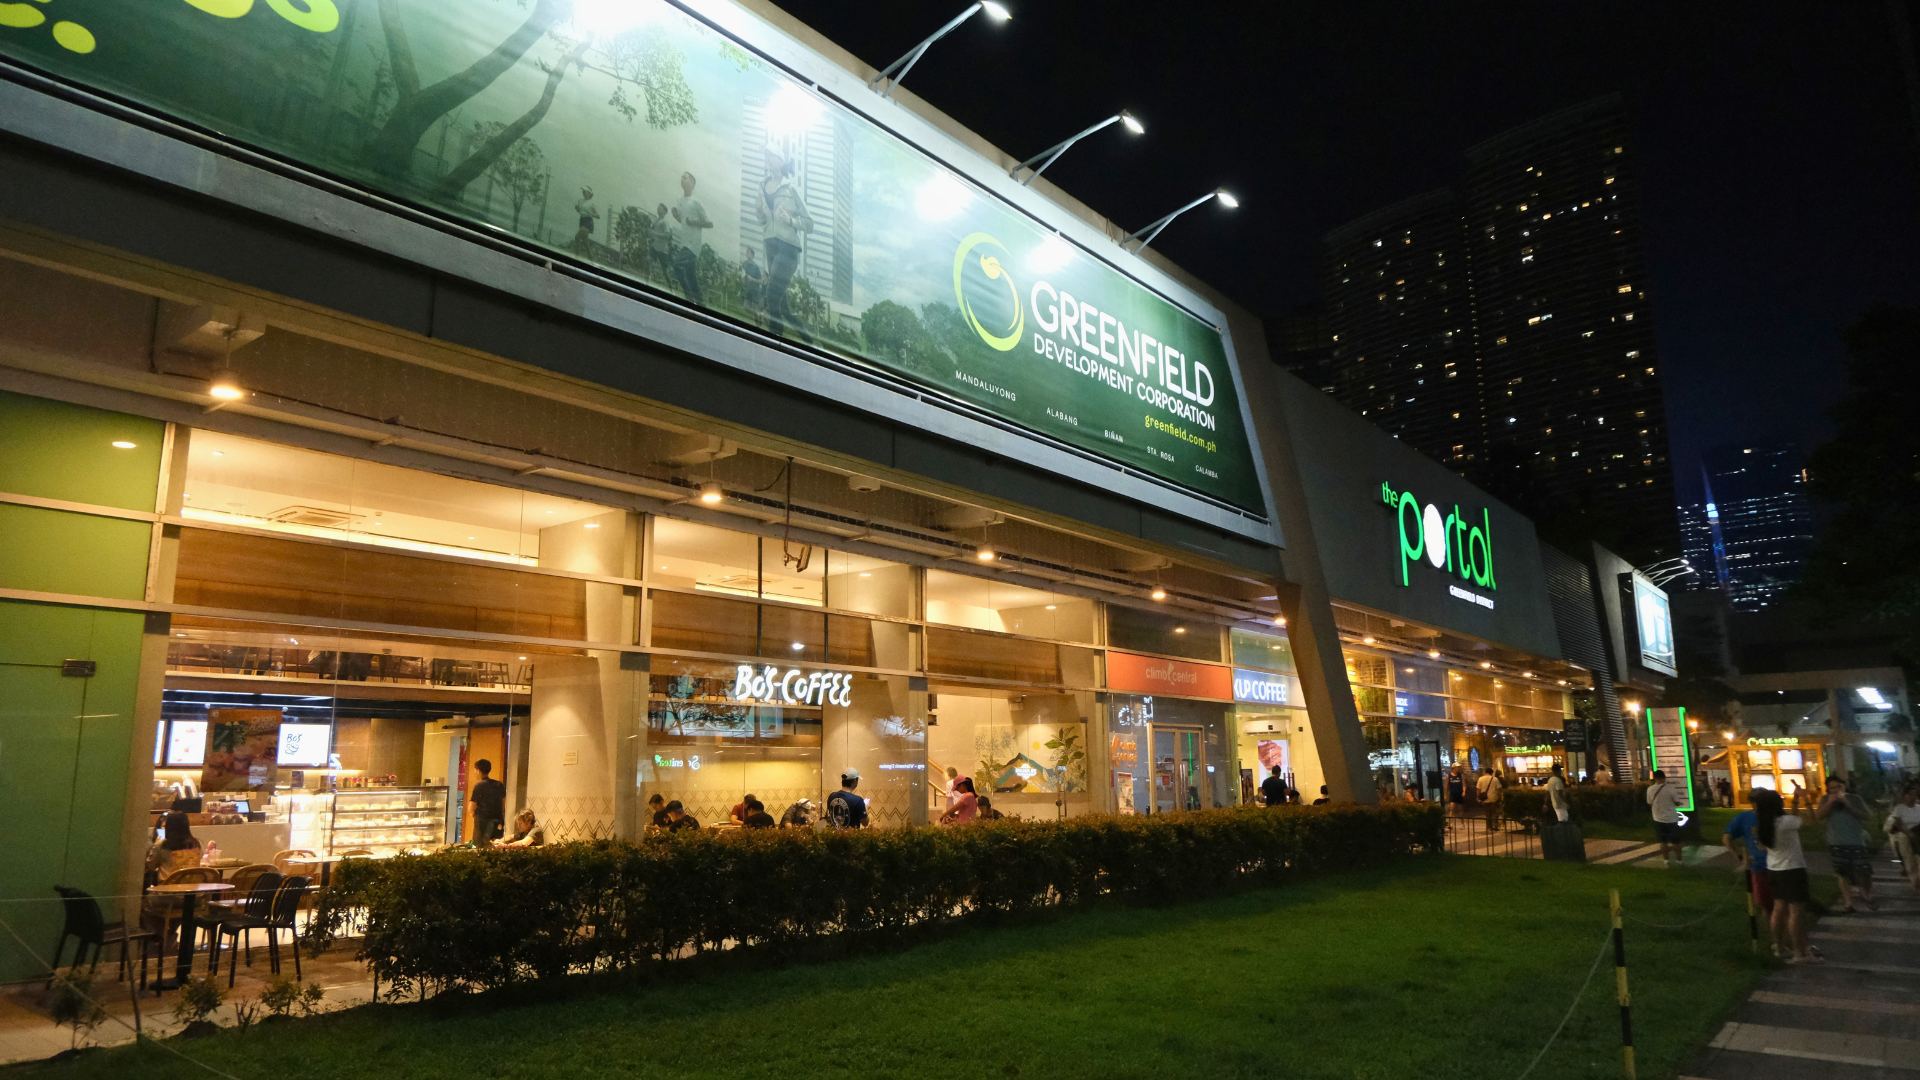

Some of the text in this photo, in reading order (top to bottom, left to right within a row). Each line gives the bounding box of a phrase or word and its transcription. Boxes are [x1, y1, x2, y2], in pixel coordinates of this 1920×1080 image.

[1030, 280, 1215, 407] GREENFIELD
[955, 370, 1017, 402] MANDALUYONG
[1034, 333, 1215, 432] DEVELOPMENT CORPORATION
[1046, 407, 1078, 426] ALABANG
[1144, 414, 1217, 453] greenfield.com.ph
[1195, 465, 1219, 479] CALAMBA
[1381, 480, 1399, 508] the
[1145, 666, 1197, 684] climb central
[1252, 680, 1287, 701] COFFEE
